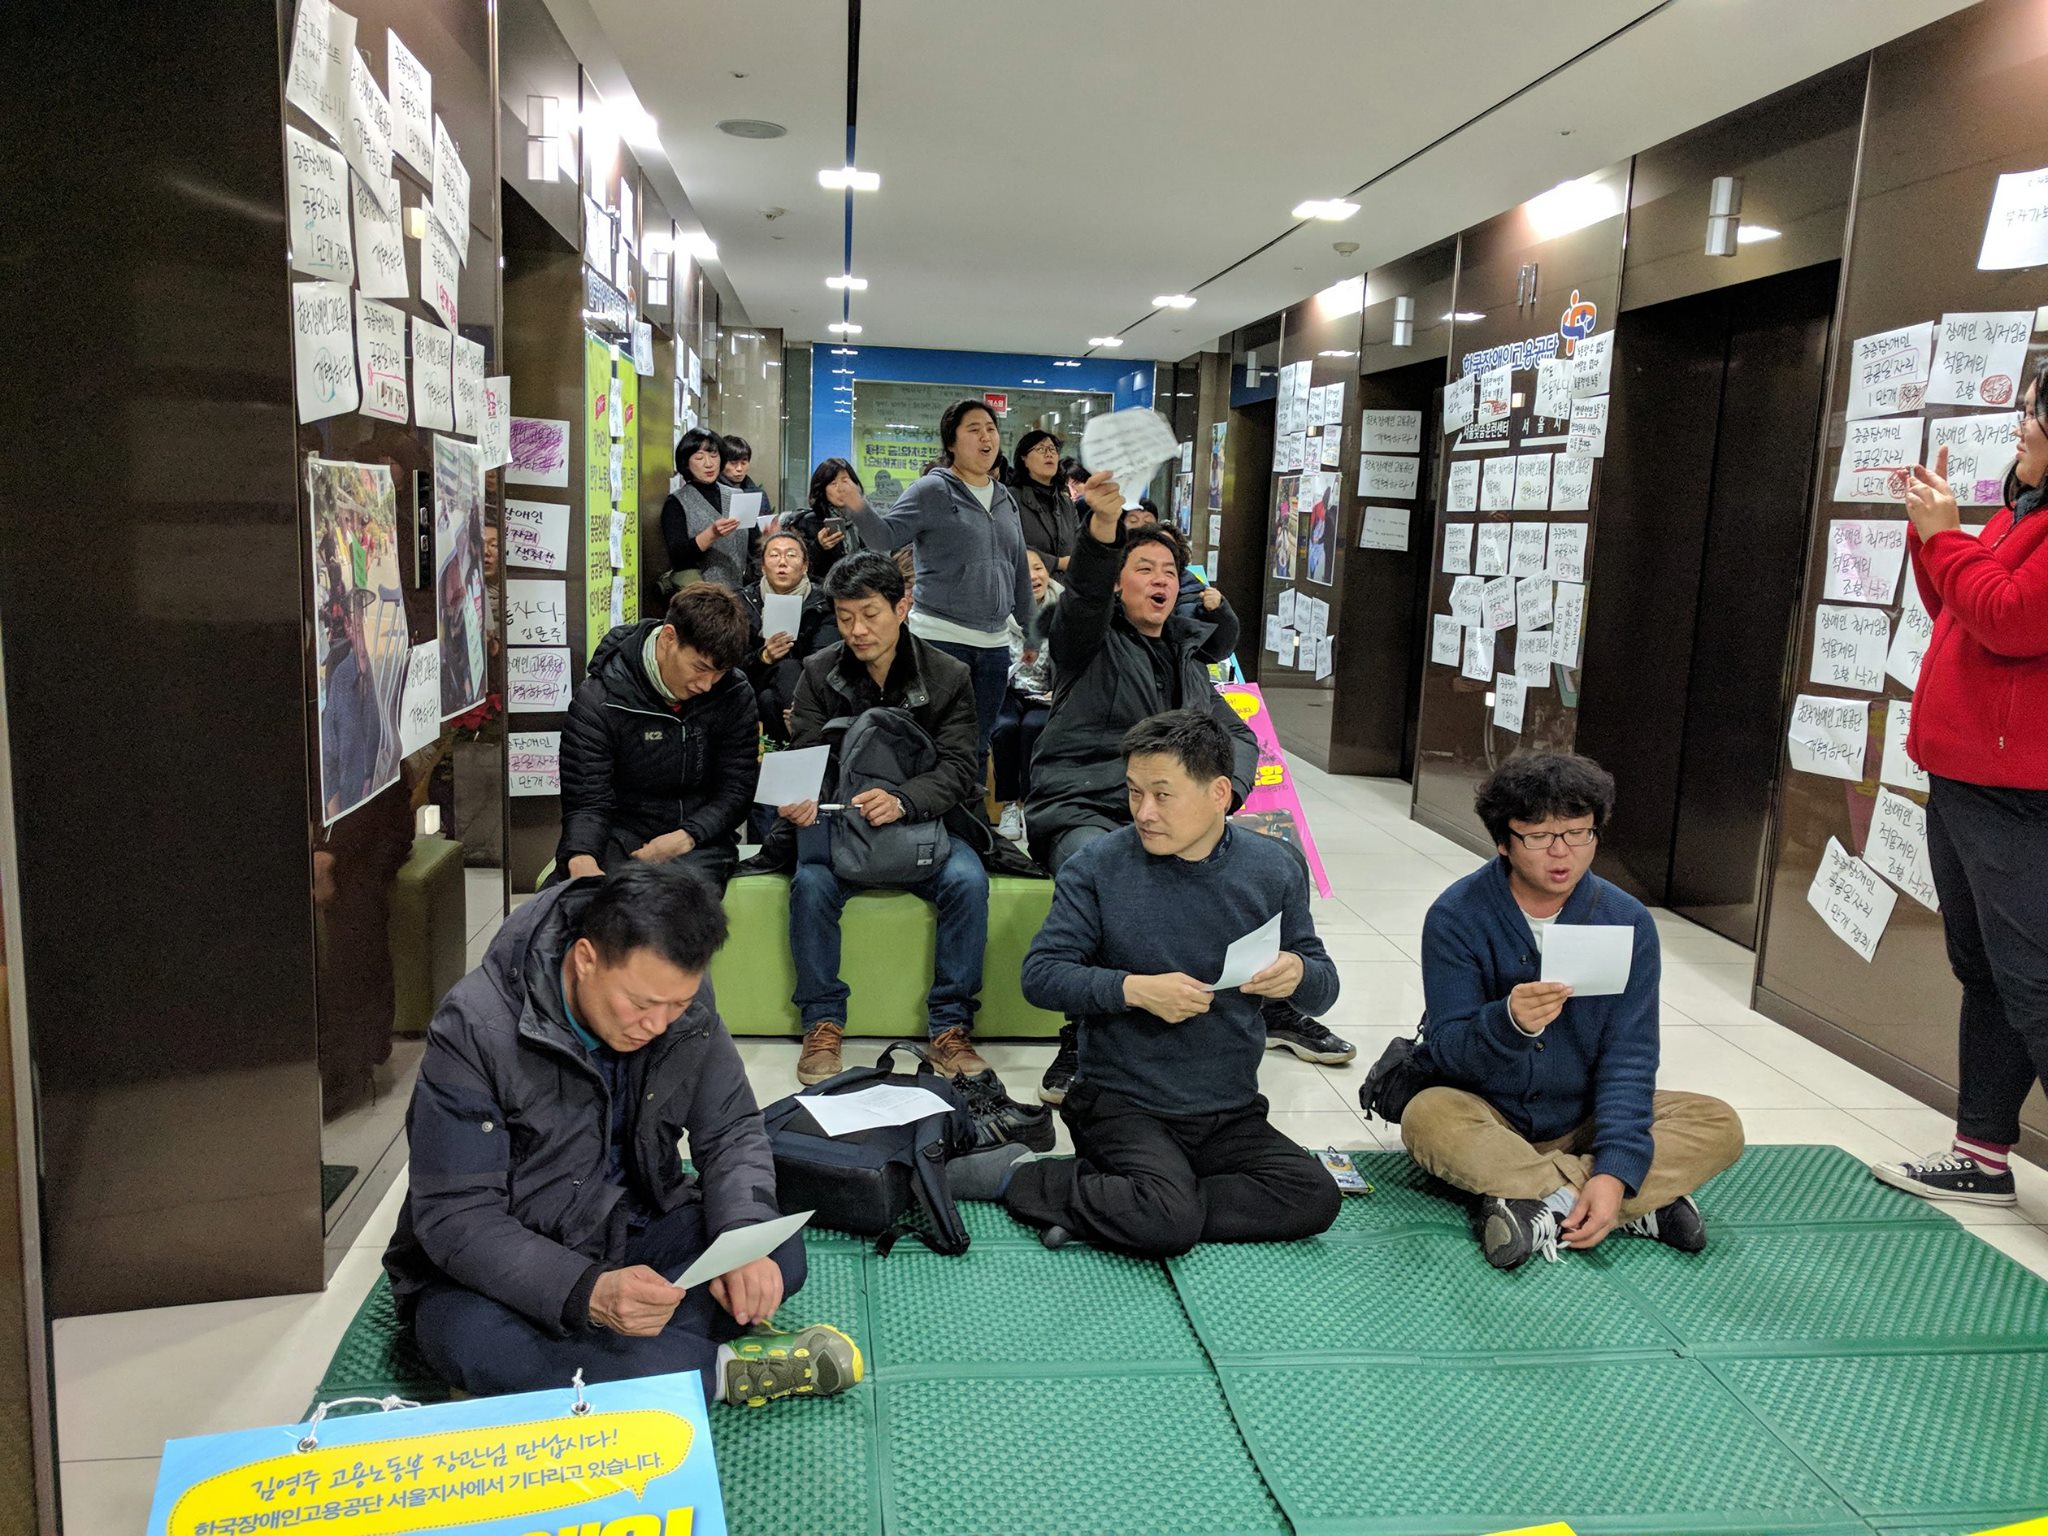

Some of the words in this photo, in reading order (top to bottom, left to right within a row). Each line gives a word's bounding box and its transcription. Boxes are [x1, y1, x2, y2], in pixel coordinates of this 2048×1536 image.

[1946, 320, 1978, 341] 장애인
[1982, 320, 2027, 344] 최저임금
[1863, 356, 1915, 383] 공공일자리
[1943, 351, 1988, 378] 적용제외
[1955, 381, 1976, 400] 조항
[1935, 425, 1968, 446] 장애인
[1853, 447, 1905, 470] 공공일자리
[1833, 527, 1862, 546] 장애인
[1832, 553, 1872, 575] 적용제외
[1821, 613, 1848, 631] 장애인
[1820, 637, 1858, 660] 적용제외
[644, 731, 663, 741] K2
[1882, 796, 1914, 827] 장애인
[1829, 870, 1874, 918] 공공일자리
[251, 1469, 320, 1502] 김영주
[328, 1455, 425, 1489] 고용노동부
[433, 1443, 507, 1473] 장관님
[514, 1428, 619, 1462] 만납시다!
[194, 1494, 383, 1536] 한국장애인고용공단
[387, 1474, 505, 1507] 서울지사에서
[509, 1460, 585, 1492] 기다리고
[588, 1450, 665, 1482] 있습니다.
